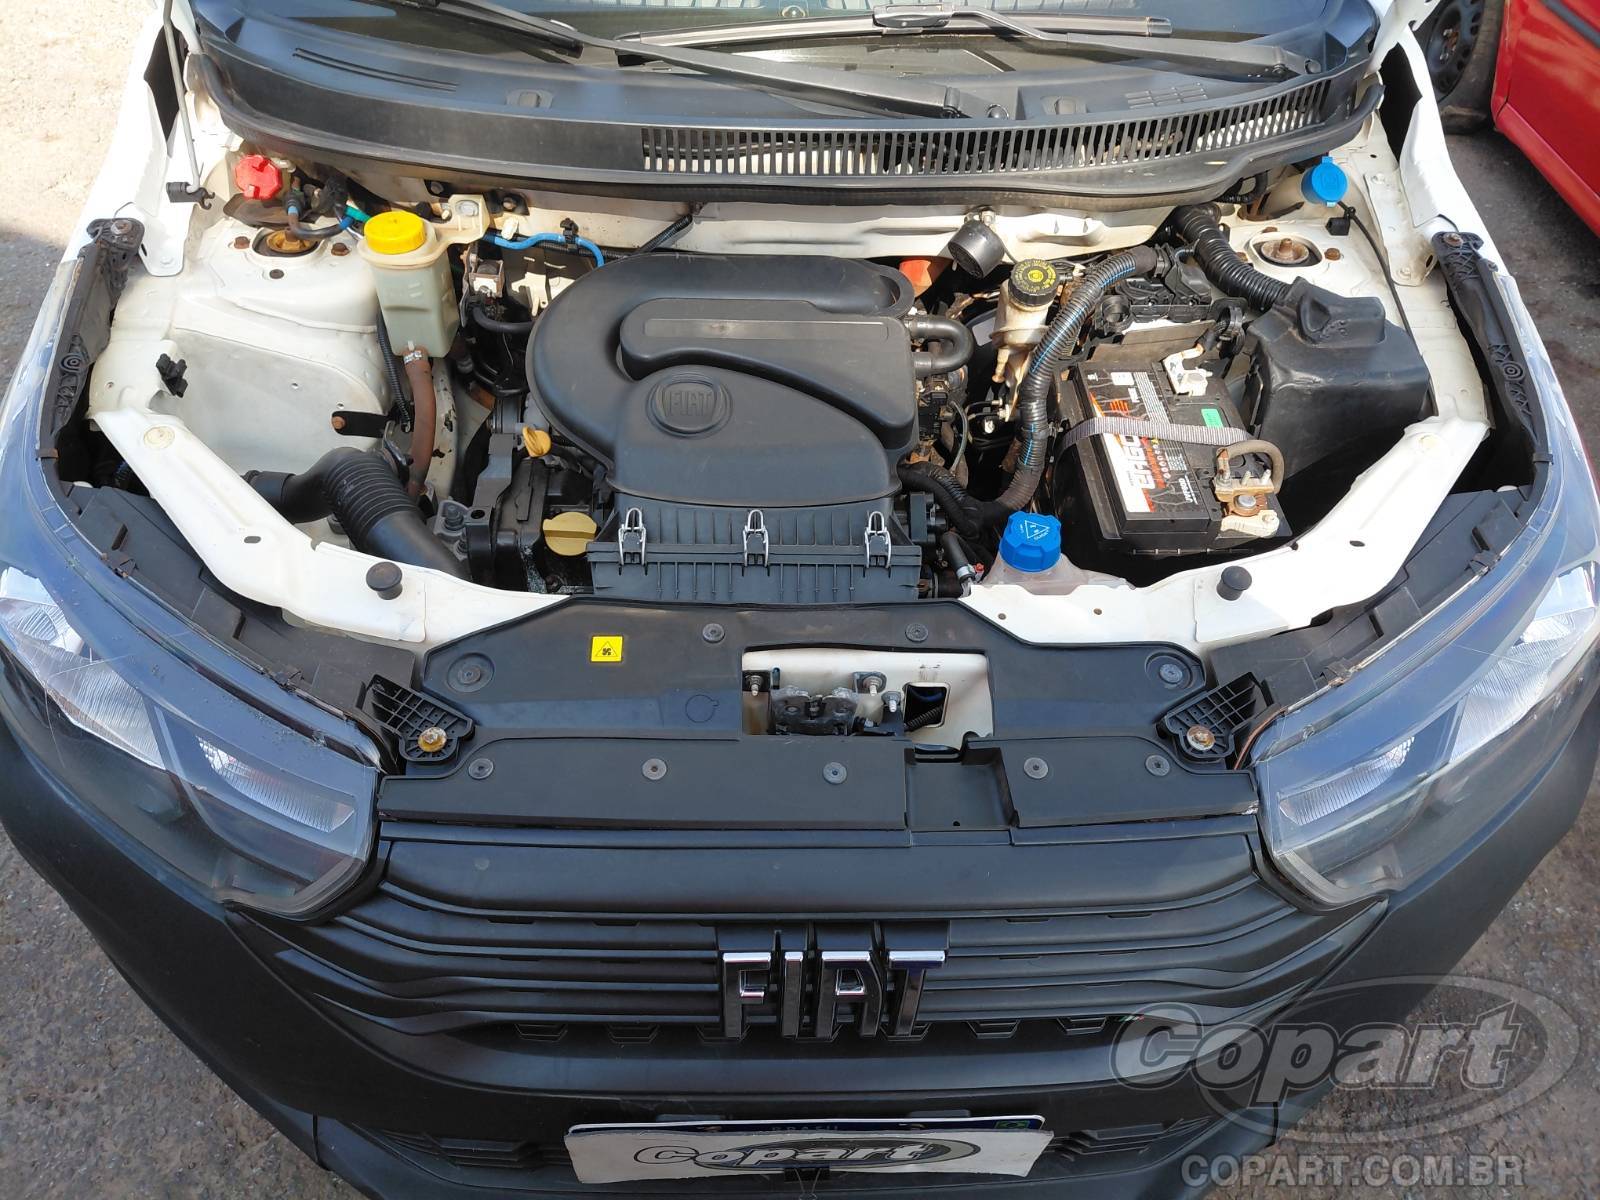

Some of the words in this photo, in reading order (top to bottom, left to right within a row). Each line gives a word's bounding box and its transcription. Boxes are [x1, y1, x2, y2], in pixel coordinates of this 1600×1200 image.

[667, 388, 715, 417] FIAT
[722, 951, 946, 1038] FIAT
[633, 1141, 933, 1166] Copart
